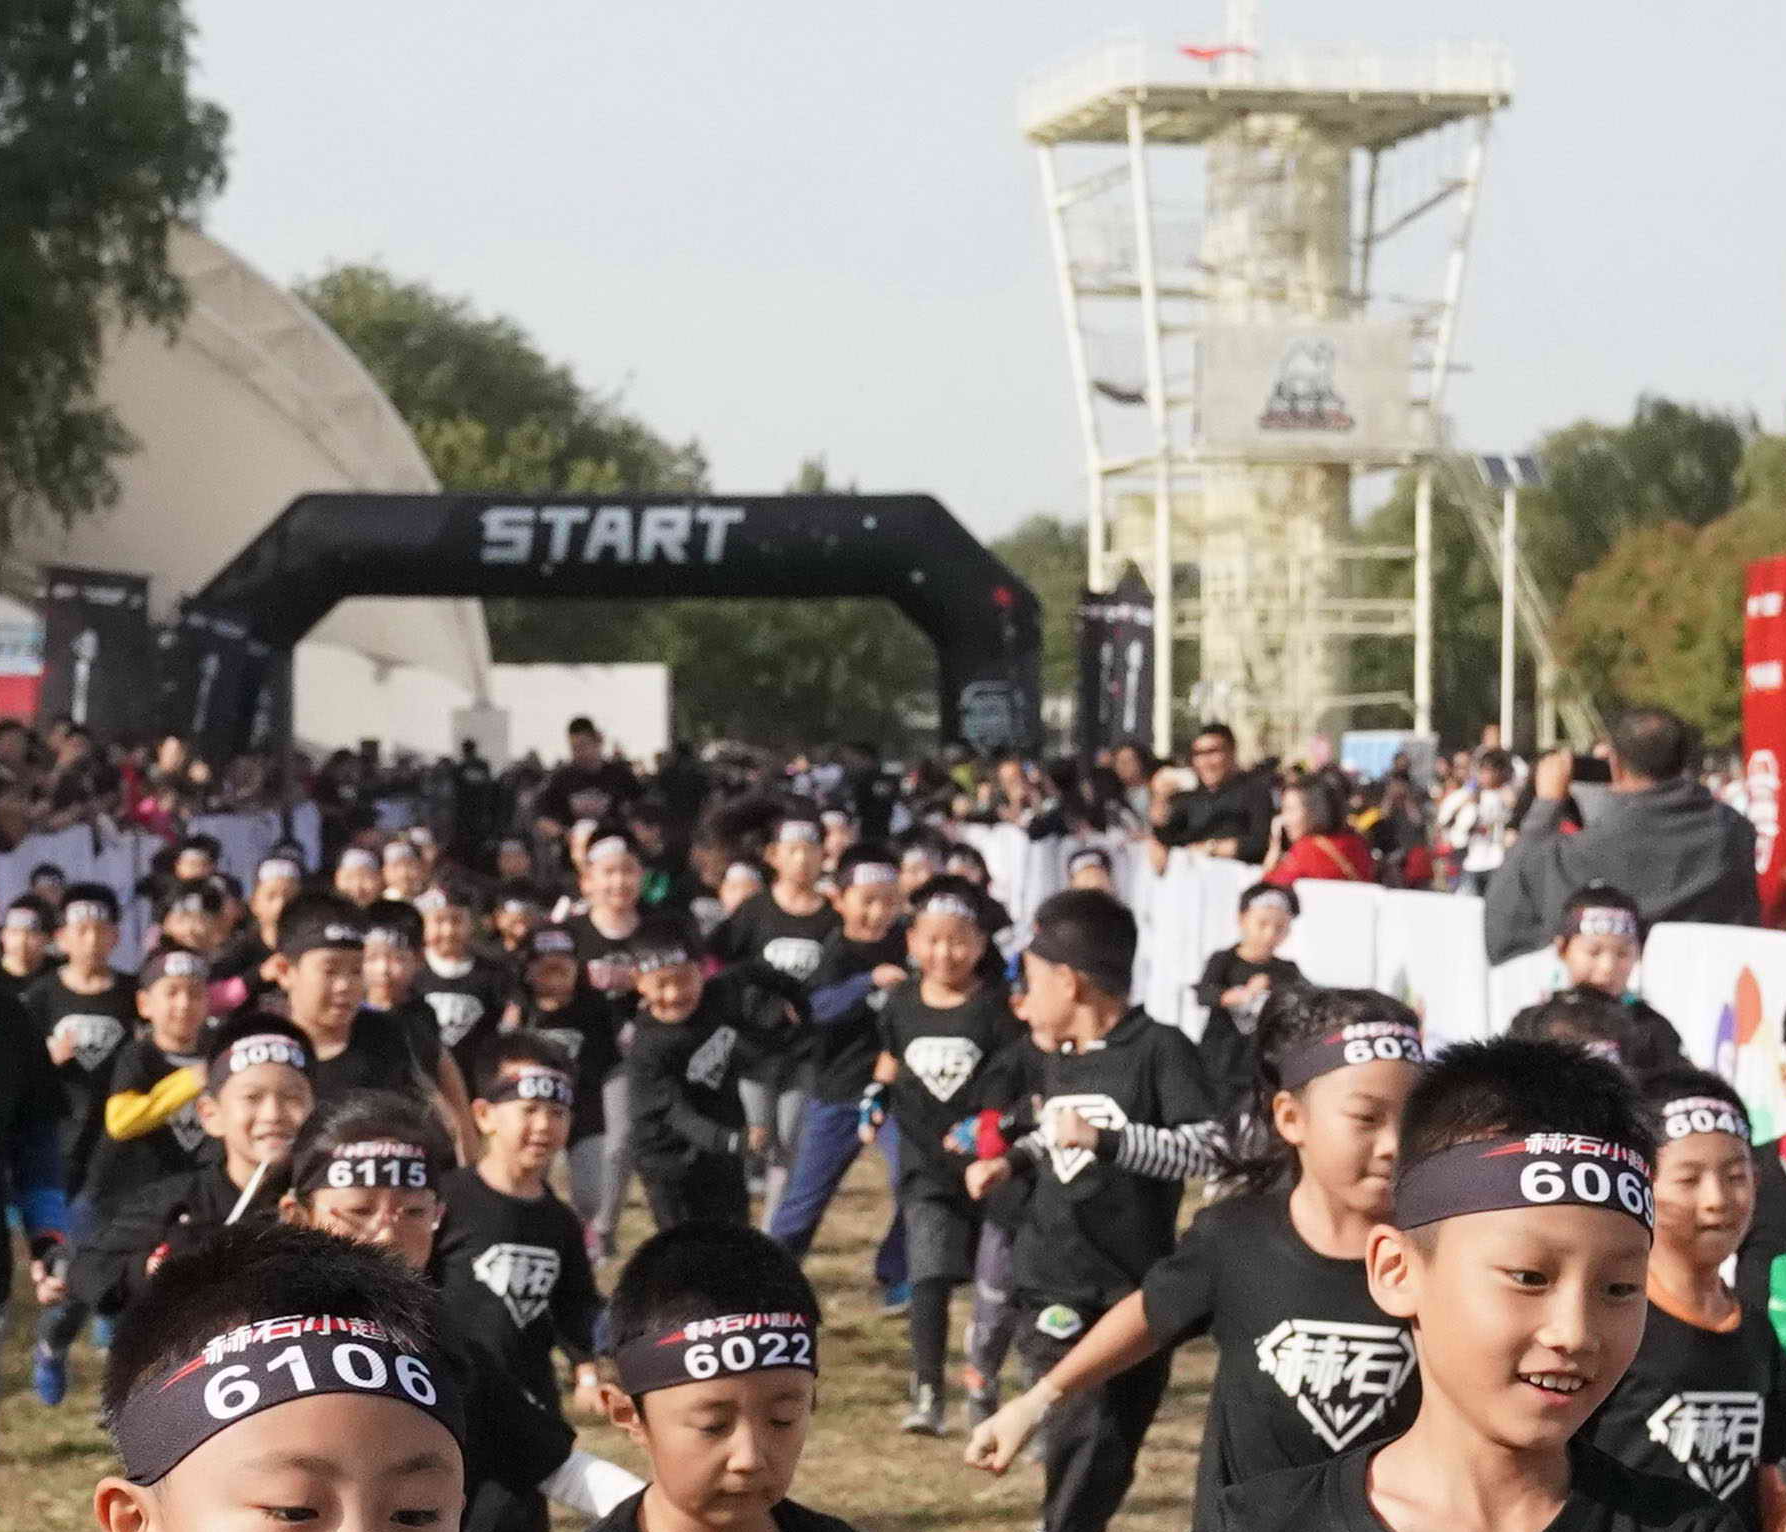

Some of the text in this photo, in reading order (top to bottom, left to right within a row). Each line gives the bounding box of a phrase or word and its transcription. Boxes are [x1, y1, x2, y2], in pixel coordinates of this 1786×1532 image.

[480, 505, 745, 564] START
[327, 1159, 427, 1189] 6115
[202, 1314, 390, 1364] 赫石小超
[684, 1332, 812, 1380] 6022
[204, 1342, 438, 1420] 6106
